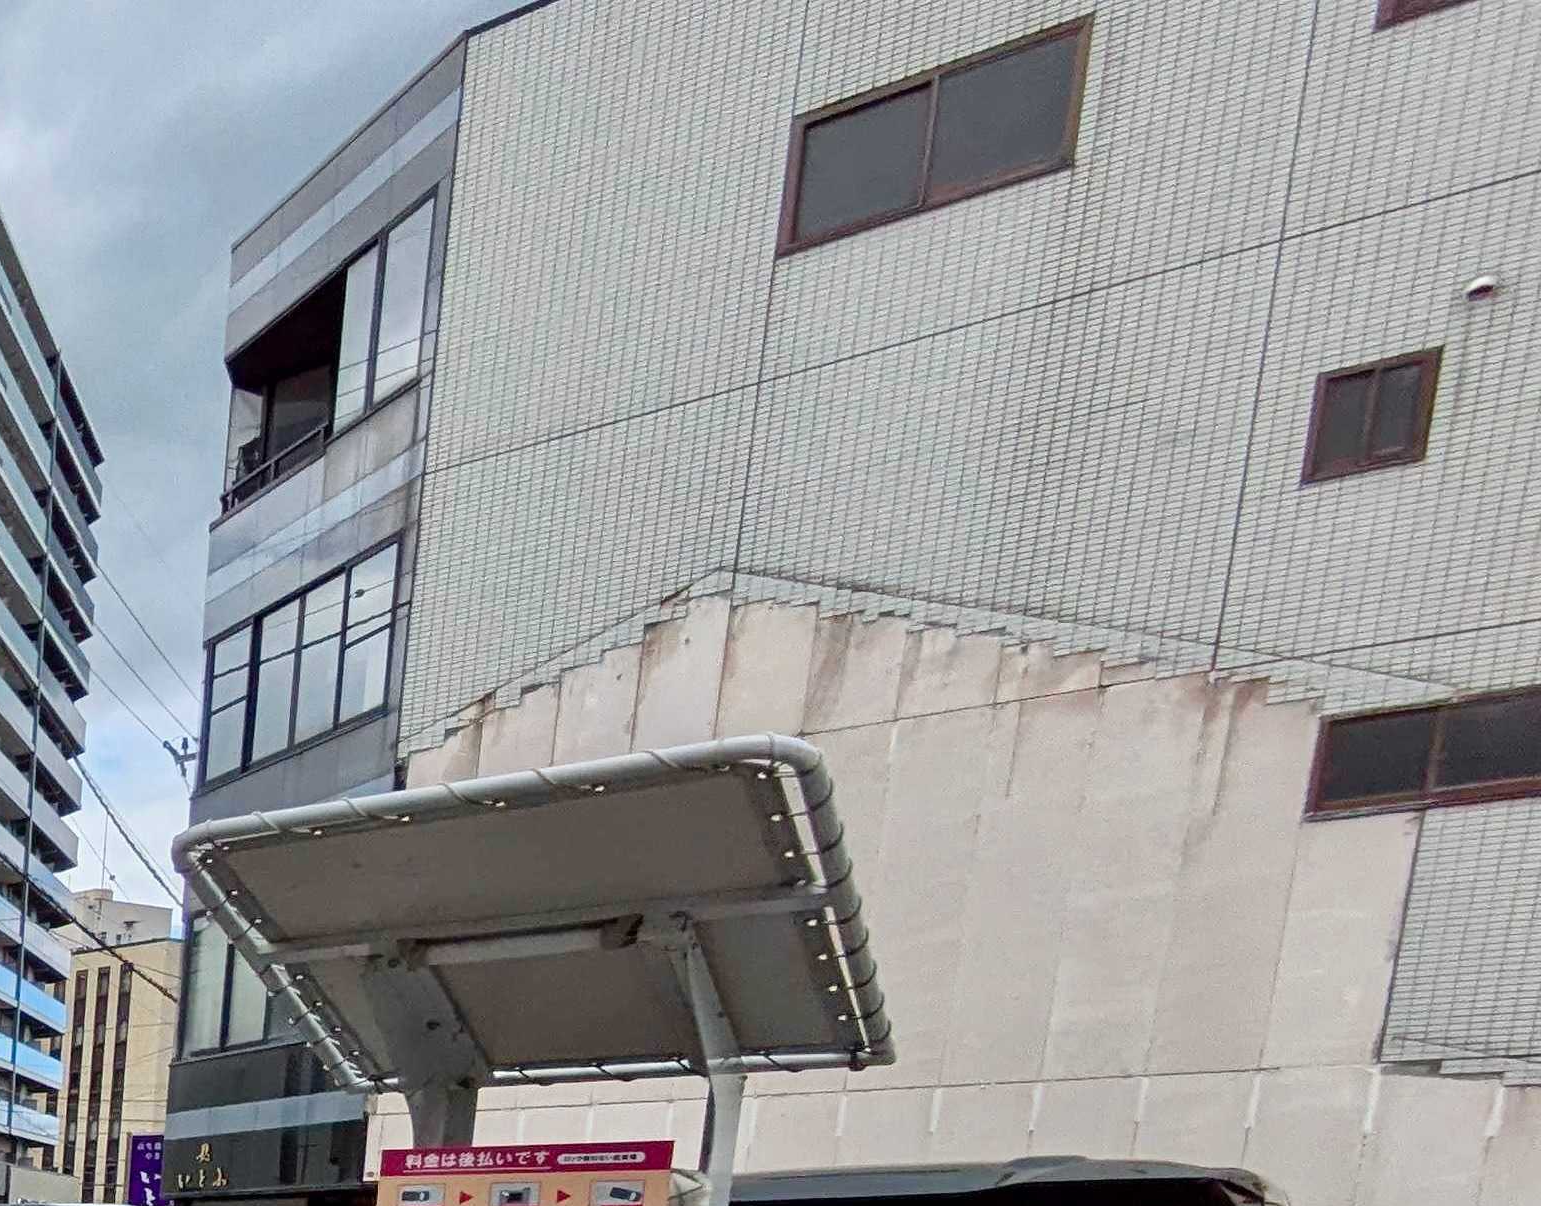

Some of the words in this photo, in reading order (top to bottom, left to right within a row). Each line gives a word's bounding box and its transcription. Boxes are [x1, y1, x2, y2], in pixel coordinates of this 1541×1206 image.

[404, 1151, 550, 1169] 料金は後払いです
